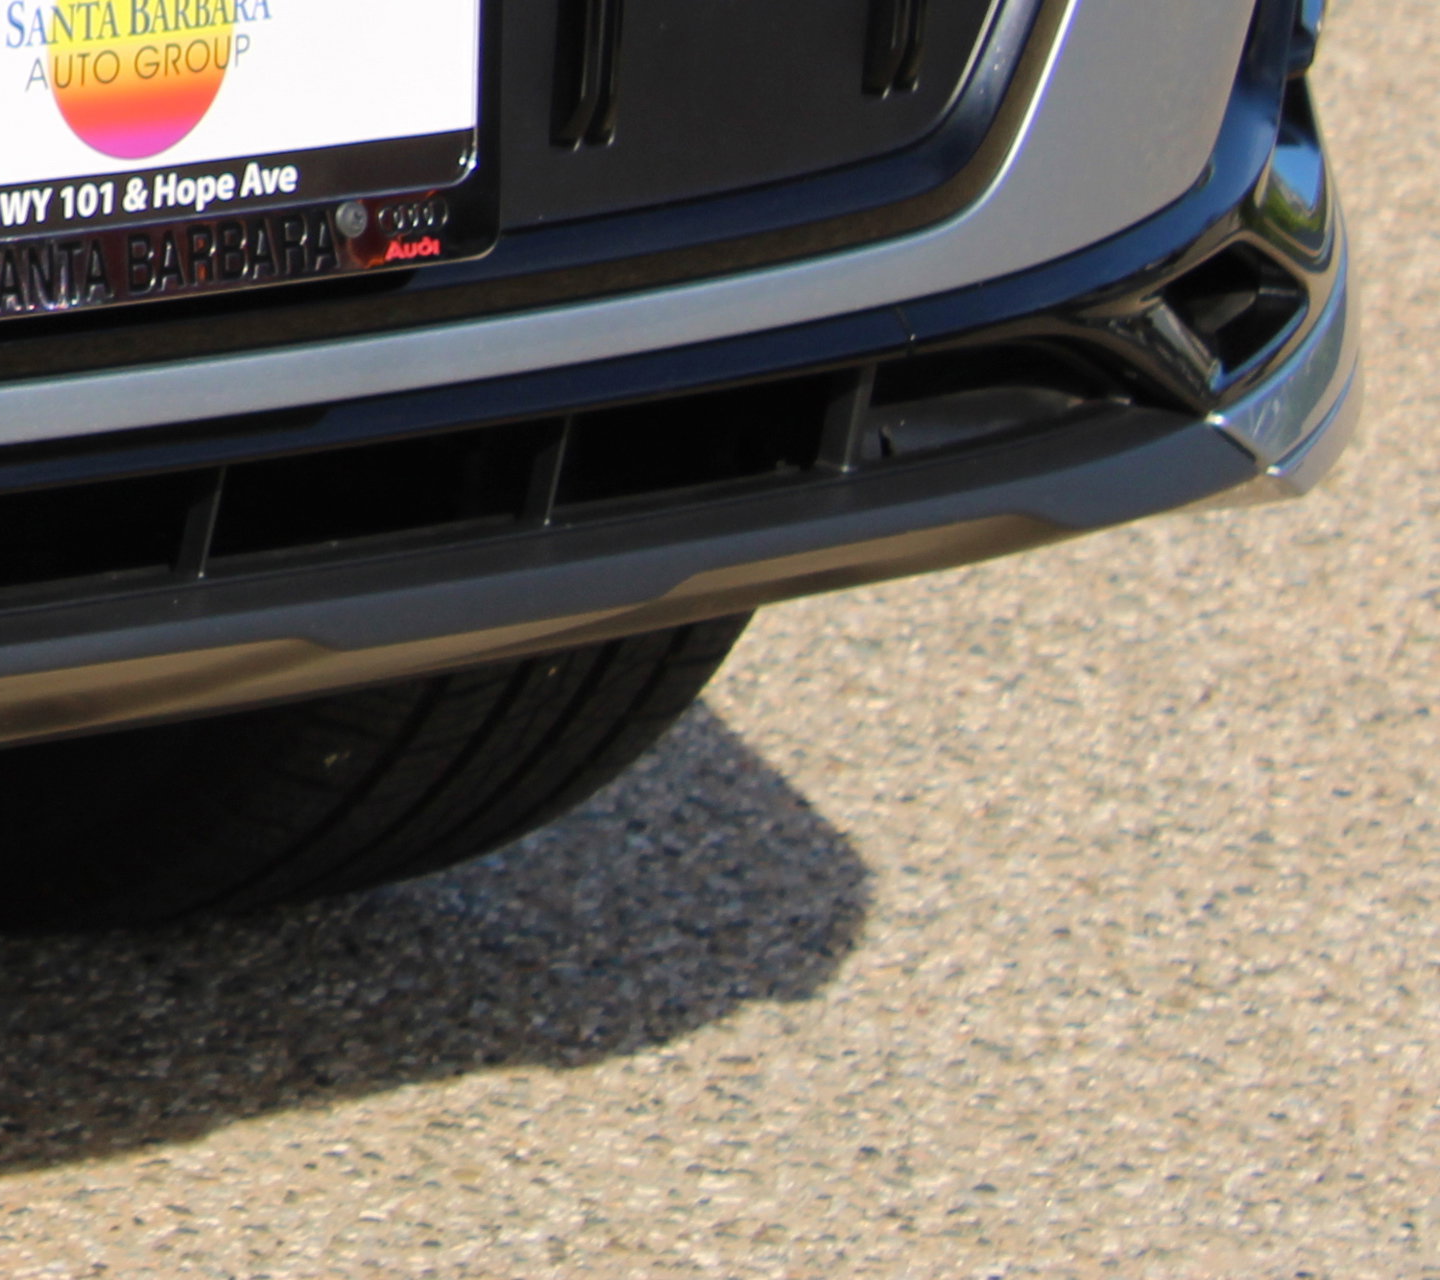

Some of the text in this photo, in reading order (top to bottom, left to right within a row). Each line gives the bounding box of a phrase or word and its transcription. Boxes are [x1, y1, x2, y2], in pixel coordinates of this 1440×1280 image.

[25, 35, 250, 94] AUTO GROUP
[59, 182, 116, 220] 101
[123, 177, 148, 212] &
[154, 168, 235, 212] Hope
[241, 162, 298, 197] Ave
[128, 210, 340, 294] BARBARA
[384, 234, 441, 260] Audi
